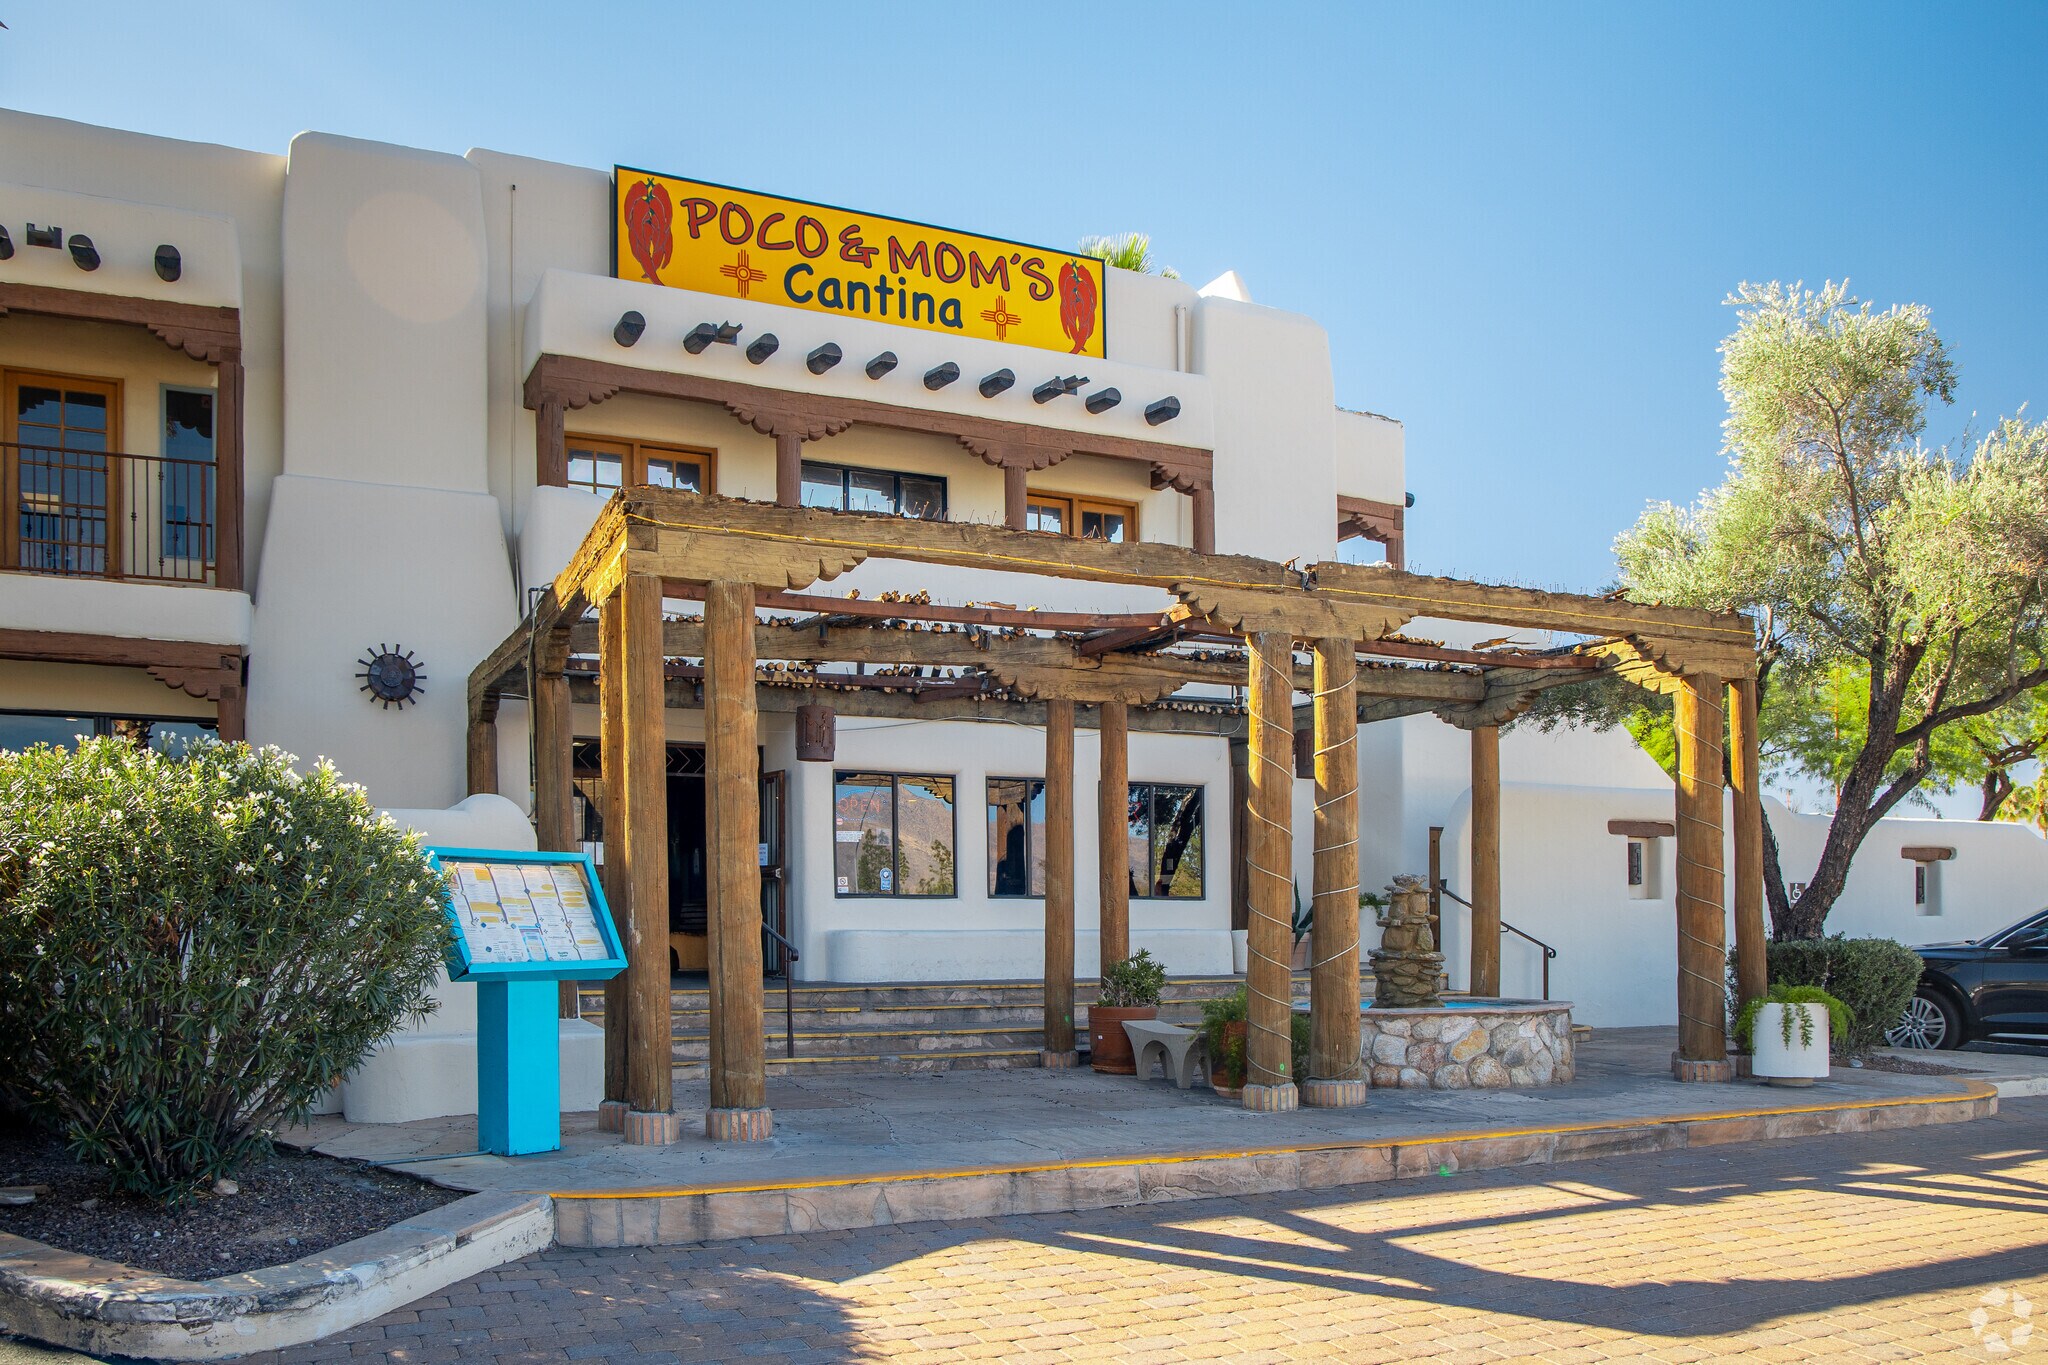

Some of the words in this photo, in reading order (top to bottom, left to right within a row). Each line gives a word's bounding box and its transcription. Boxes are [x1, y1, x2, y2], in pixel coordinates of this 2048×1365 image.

[680, 198, 828, 258] POCO
[838, 225, 879, 268] &
[887, 236, 1054, 301] MOM'S
[784, 263, 963, 329] Cantina
[838, 798, 880, 812] OPEN
